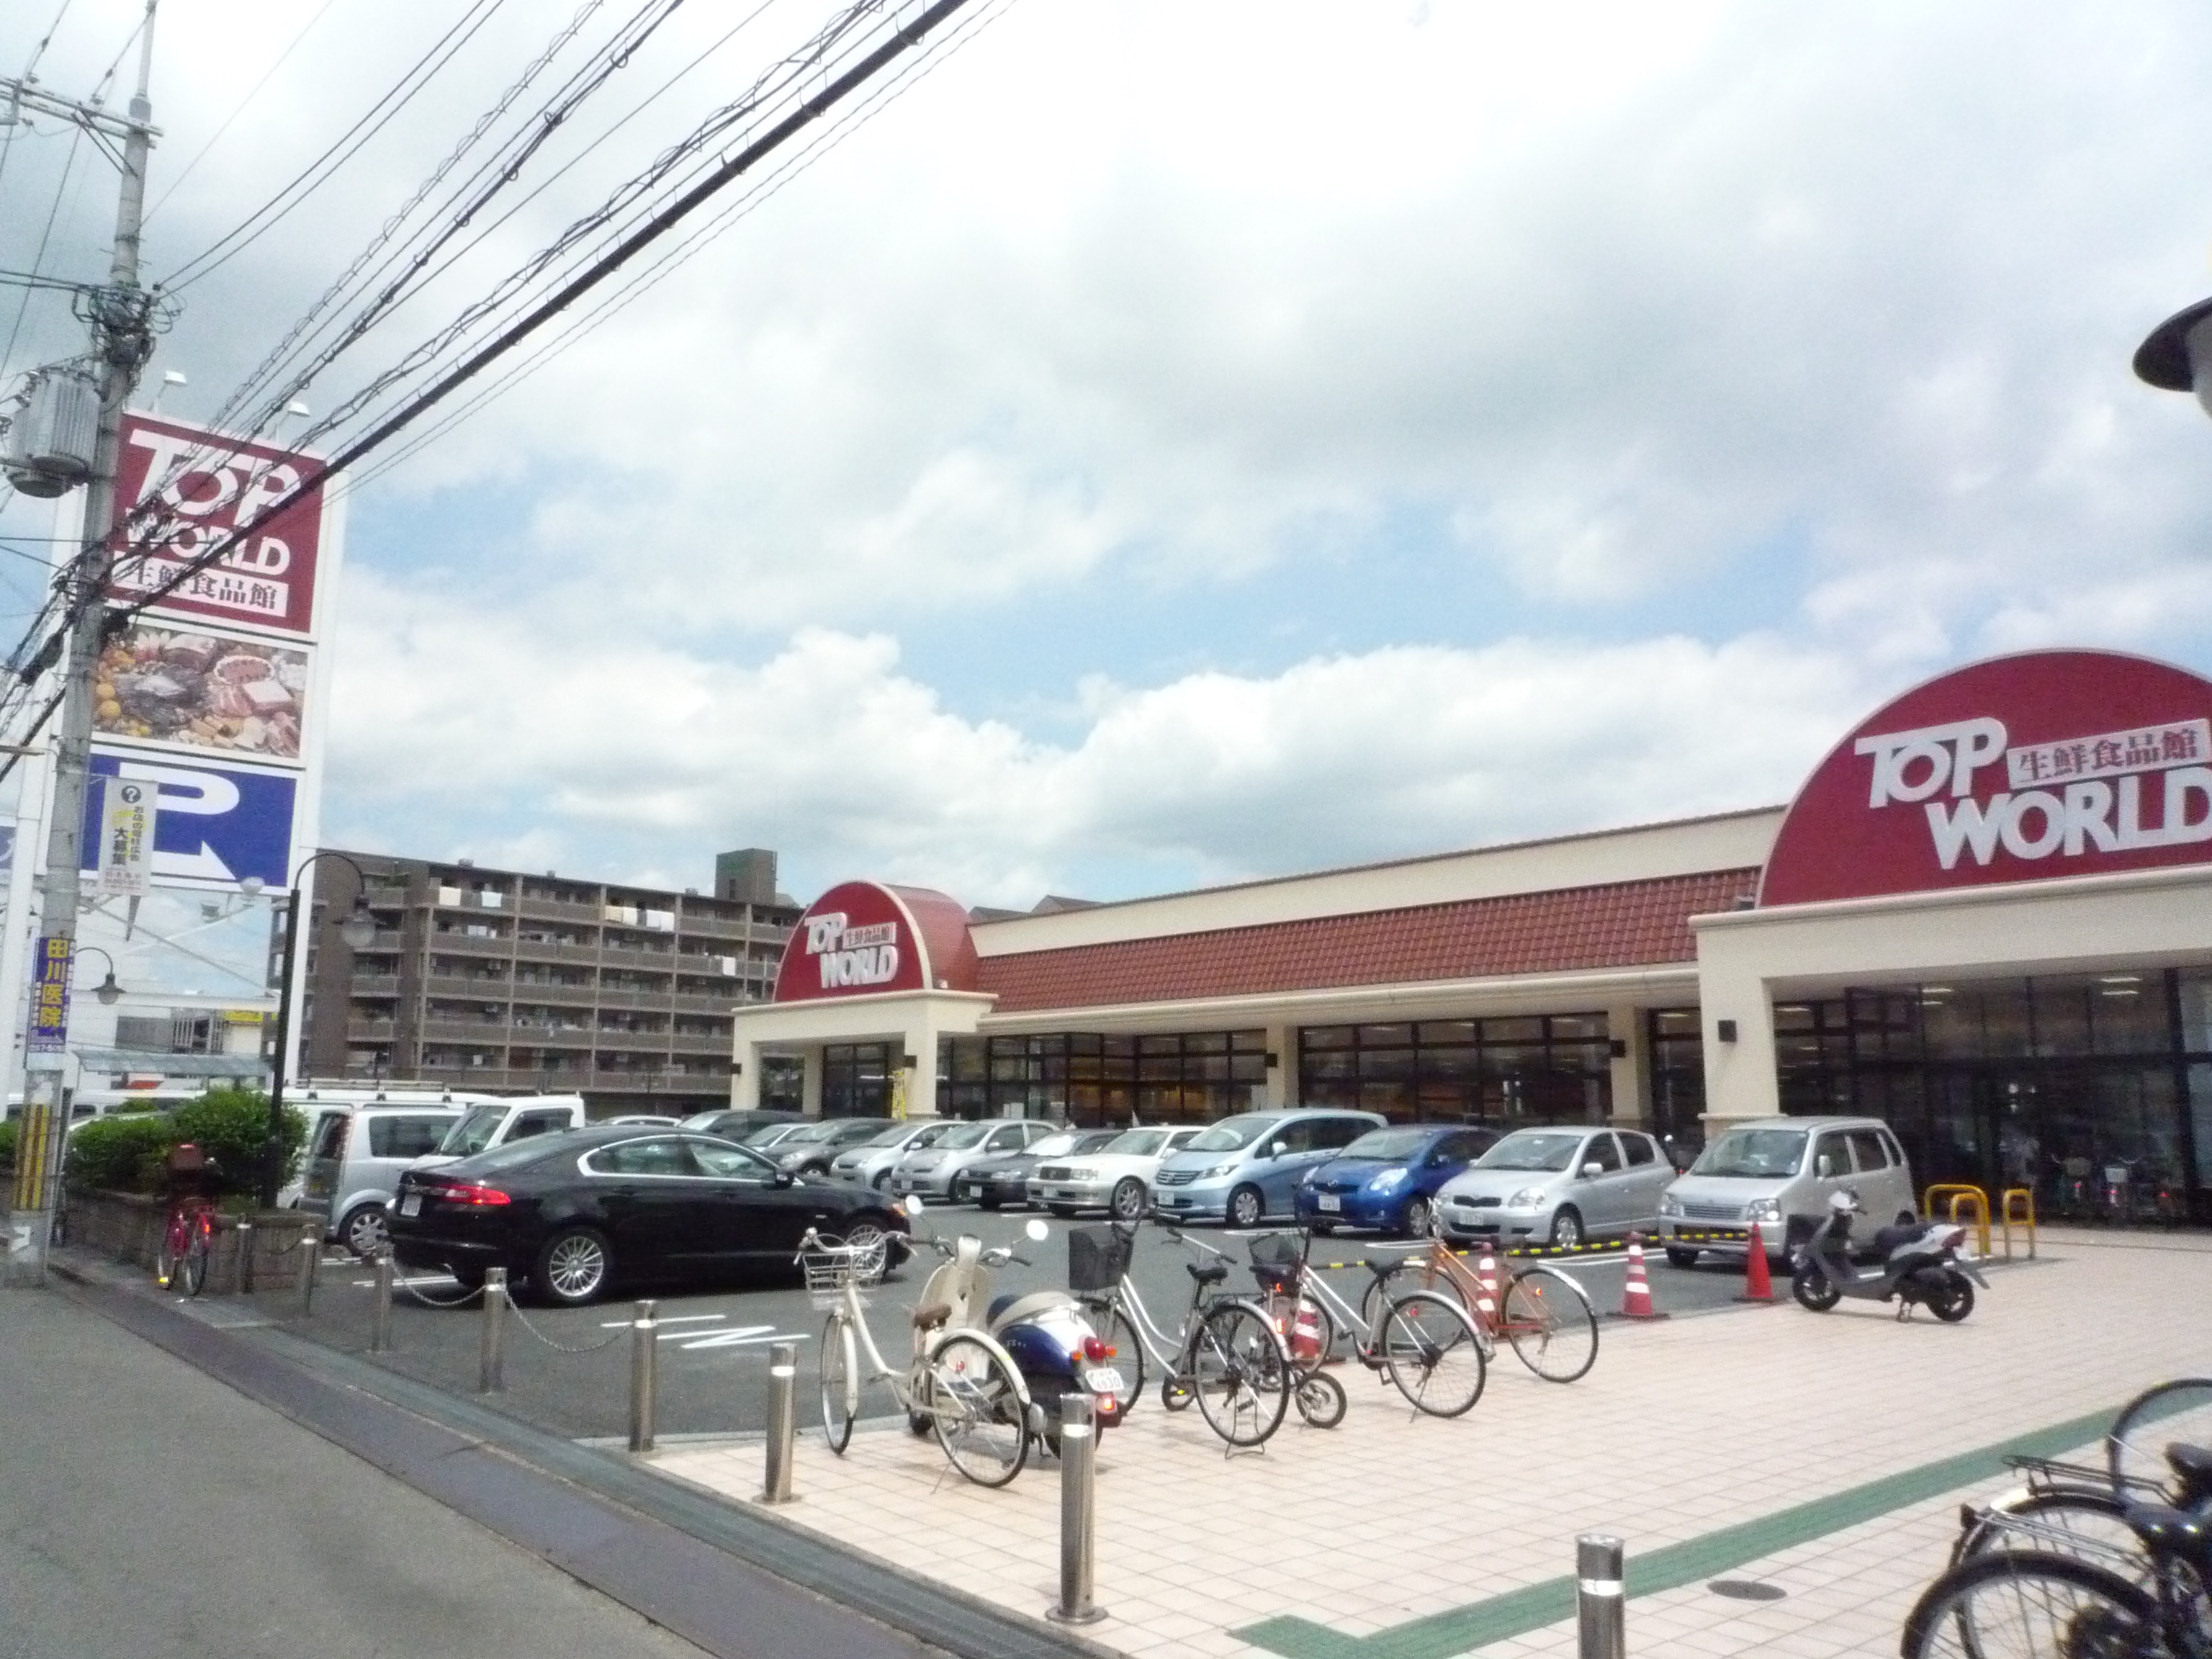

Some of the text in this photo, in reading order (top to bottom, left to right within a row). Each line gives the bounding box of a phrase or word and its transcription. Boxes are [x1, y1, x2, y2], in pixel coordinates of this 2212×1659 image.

[130, 428, 302, 528] TOP
[1854, 716, 2008, 809] TOP
[2018, 728, 2198, 781] 生鮮食品館
[1925, 765, 2212, 870] WORLD
[804, 912, 848, 956] TOP
[819, 945, 899, 989] WORLD
[39, 939, 68, 1028] 田川医院
